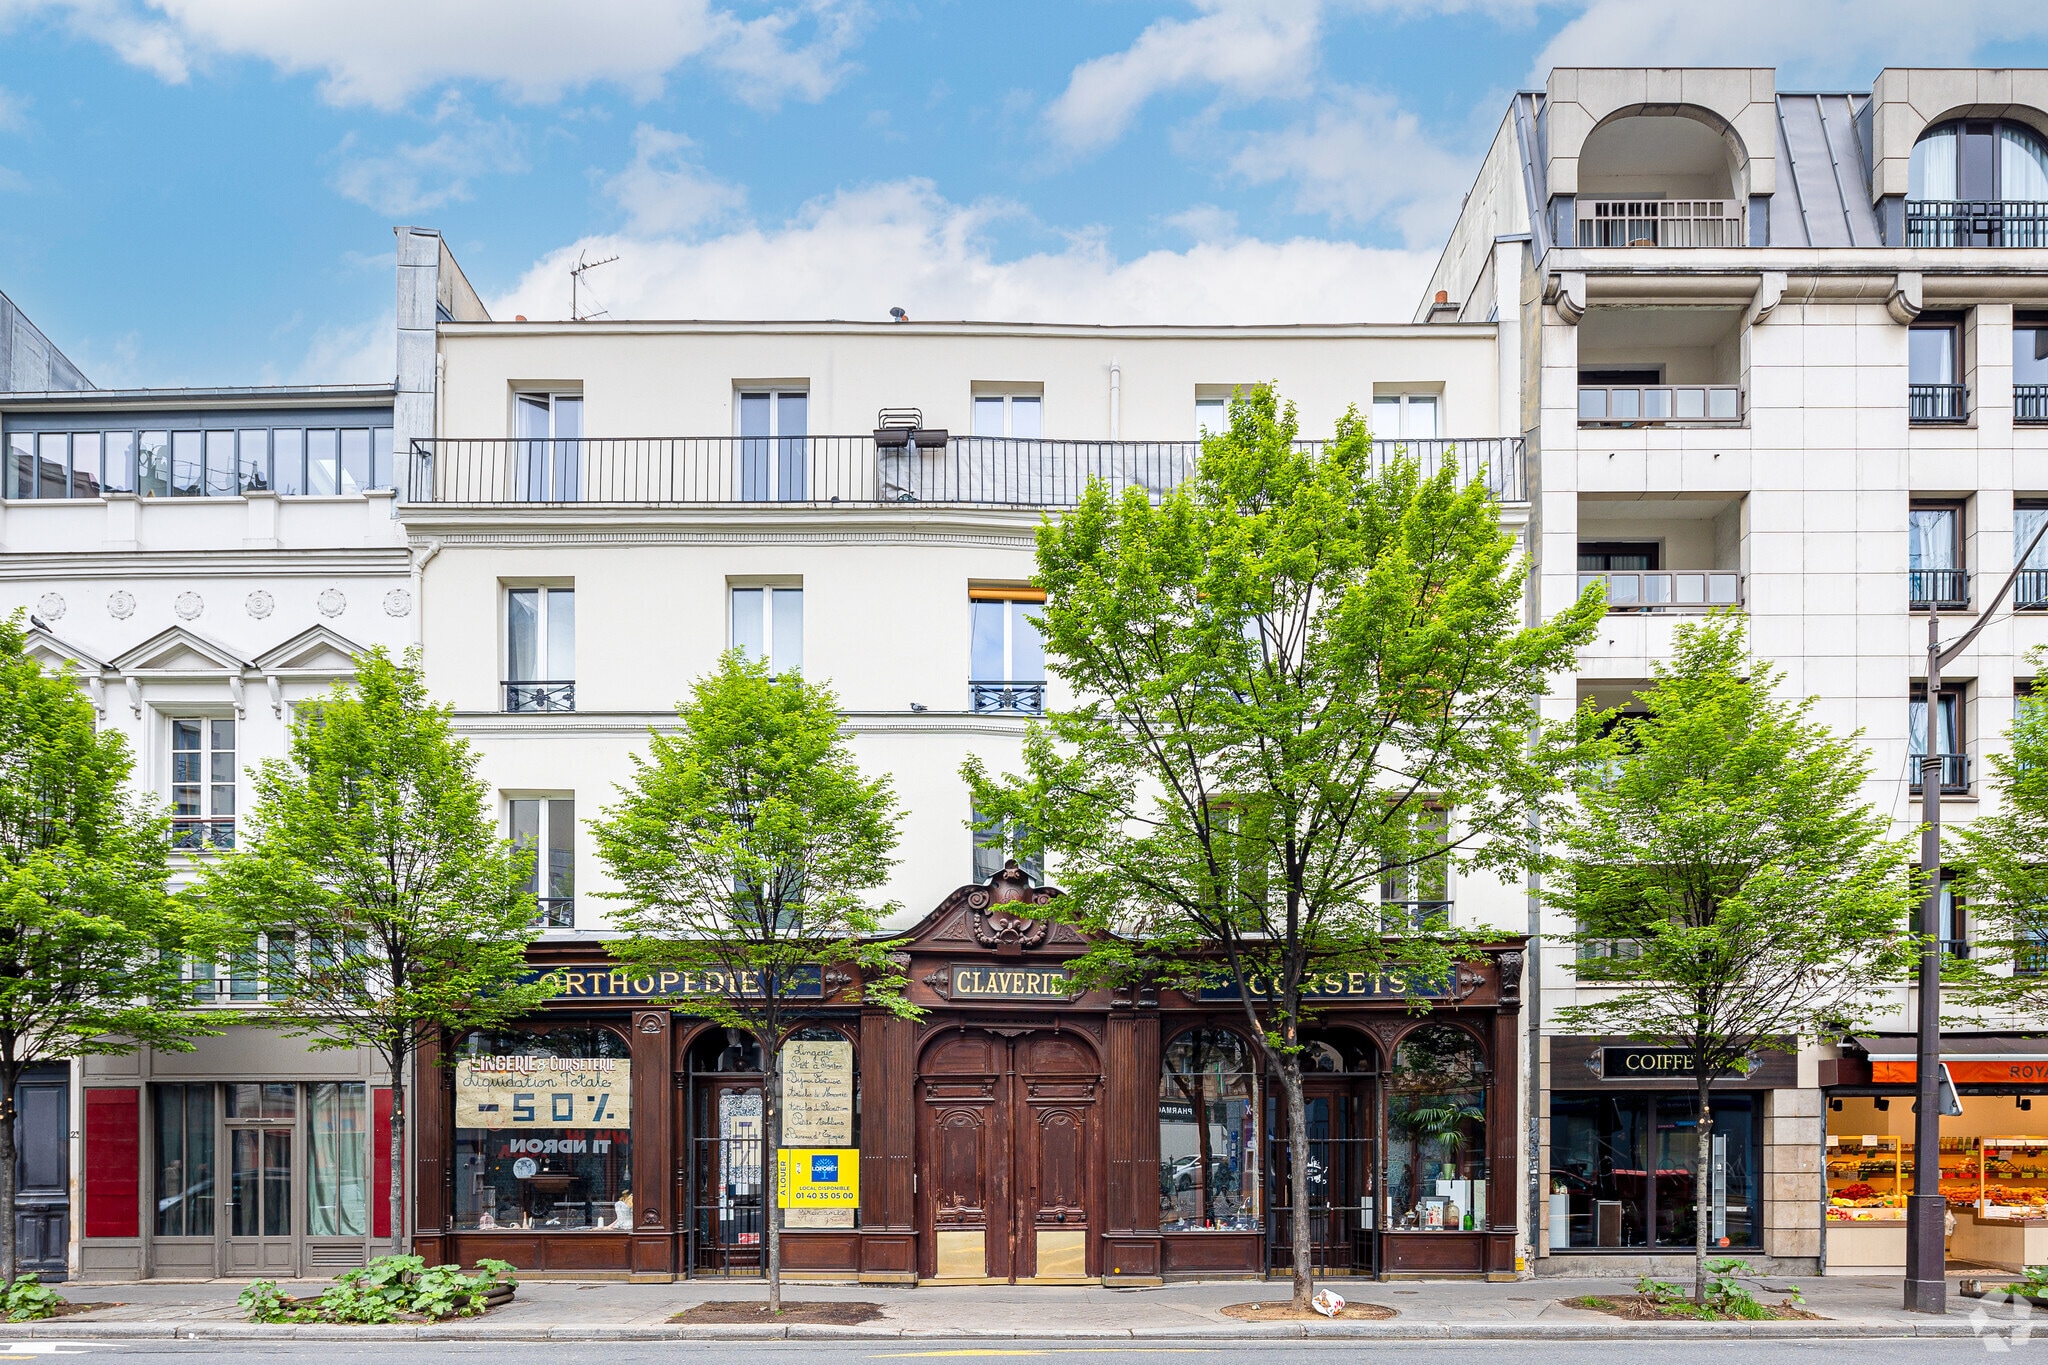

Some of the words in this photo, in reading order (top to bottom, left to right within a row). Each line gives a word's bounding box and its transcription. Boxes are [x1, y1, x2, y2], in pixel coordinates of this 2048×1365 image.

[540, 971, 760, 995] ORTHOPEDIE
[957, 971, 1063, 995] CLAVERIE
[470, 1053, 538, 1076] LINGERIE
[550, 1055, 616, 1076] CORSETERIE
[794, 1044, 834, 1063] Lingerie
[463, 1068, 558, 1093] Liquidation
[560, 1071, 612, 1089] Totale
